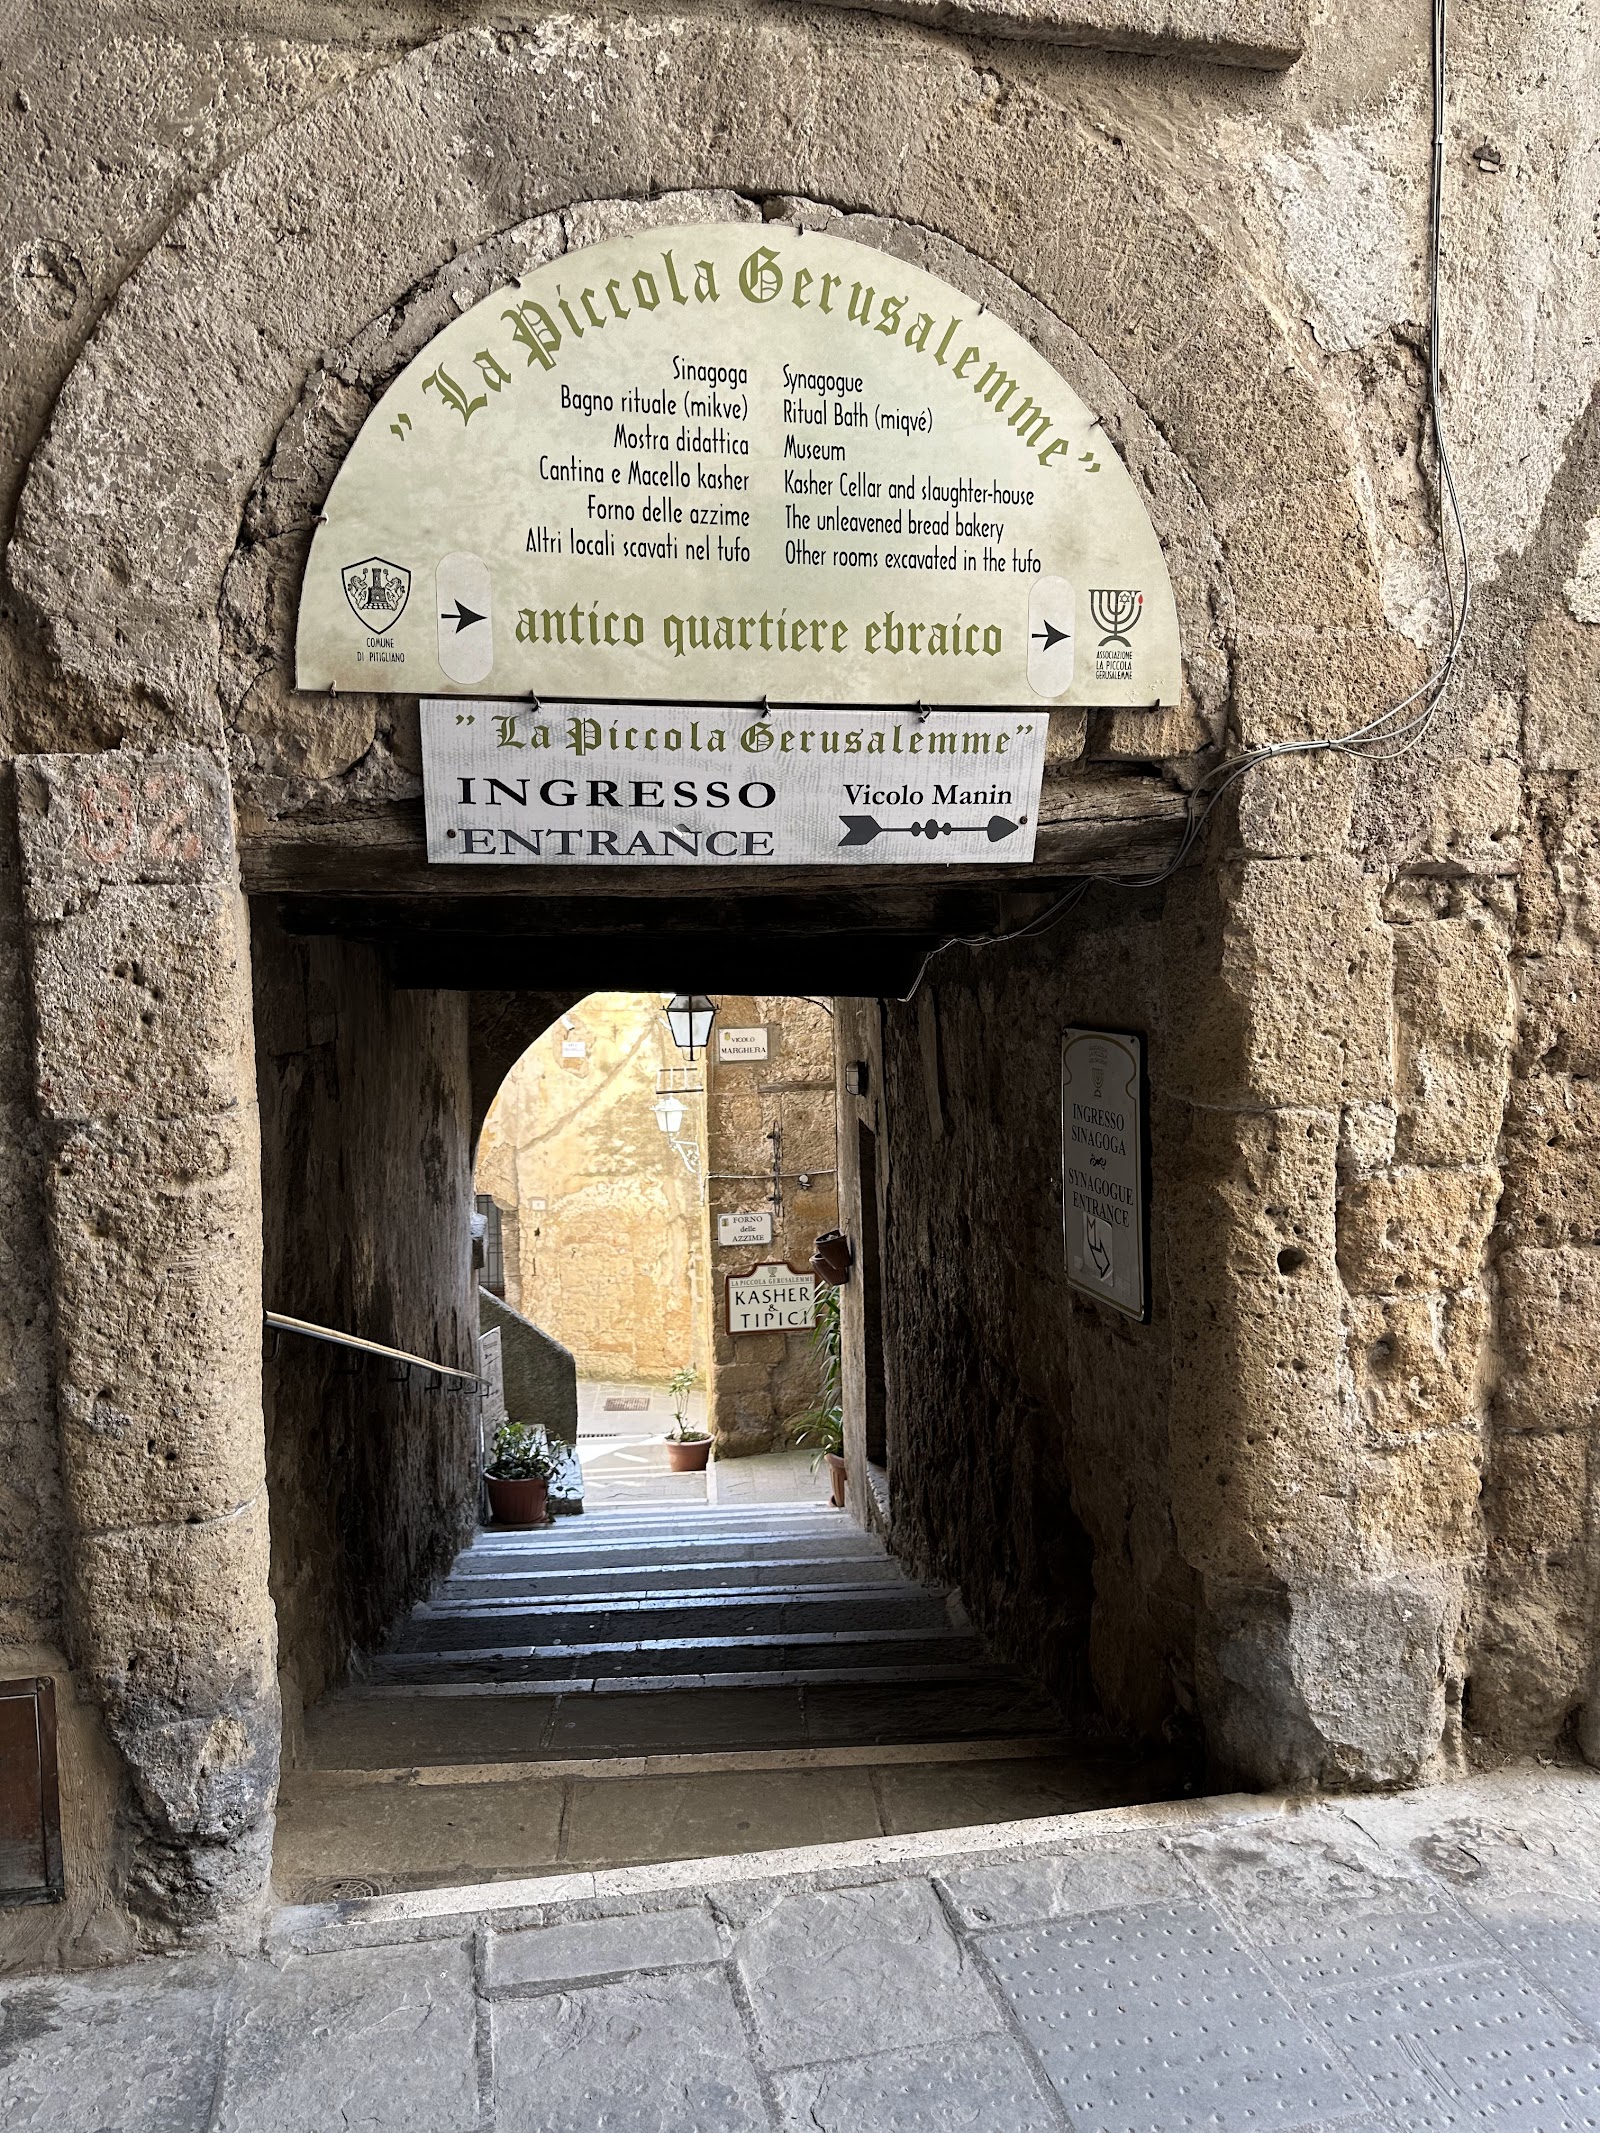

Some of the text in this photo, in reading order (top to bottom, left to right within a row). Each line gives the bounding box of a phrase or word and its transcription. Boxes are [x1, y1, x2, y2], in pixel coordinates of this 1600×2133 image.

[422, 349, 512, 426] La
[500, 249, 720, 371] Piccola
[673, 355, 748, 389] Sinagoga
[782, 363, 864, 398] Synagogue
[561, 384, 748, 422] Bagno rituale (mikve)
[783, 397, 933, 437] Ritual Bath (miqvé)
[613, 423, 749, 456] Mostra didattica
[783, 434, 846, 461] Museum
[539, 454, 750, 491] Cantina e Macello kasher
[784, 468, 1035, 509] Kasher Cellar and slaughter-house
[587, 494, 750, 527] Forno delle azzime
[785, 503, 1004, 545] The unleavened bread bakery
[525, 525, 751, 563] Altri locali scavati nel tufo
[785, 538, 1041, 574] Other rooms excavated in the tufo
[367, 638, 394, 648] COMUNE
[516, 600, 1001, 657] antico quartiere ebraico
[357, 652, 404, 662] DI PITIGLIANO
[1096, 651, 1132, 659] ASSOCIAZIONE
[1096, 661, 1132, 670] LA PICCOLA
[1096, 671, 1132, 679] GERUSALEMME
[491, 715, 551, 749] La
[566, 717, 726, 756] Piccola
[457, 777, 776, 809] INGRESSO
[843, 784, 1012, 805] Vicolo Manin
[458, 828, 775, 857] ENTRANCE
[1073, 1103, 1124, 1131] INGRESSO
[1071, 1126, 1126, 1156] SINAGOGA
[1068, 1168, 1133, 1205] SYNAGOGUE
[1073, 1191, 1129, 1227] ENTRANCE
[735, 1287, 810, 1305] KASHER
[768, 1304, 778, 1312] &
[740, 1311, 807, 1328] TIPICI
